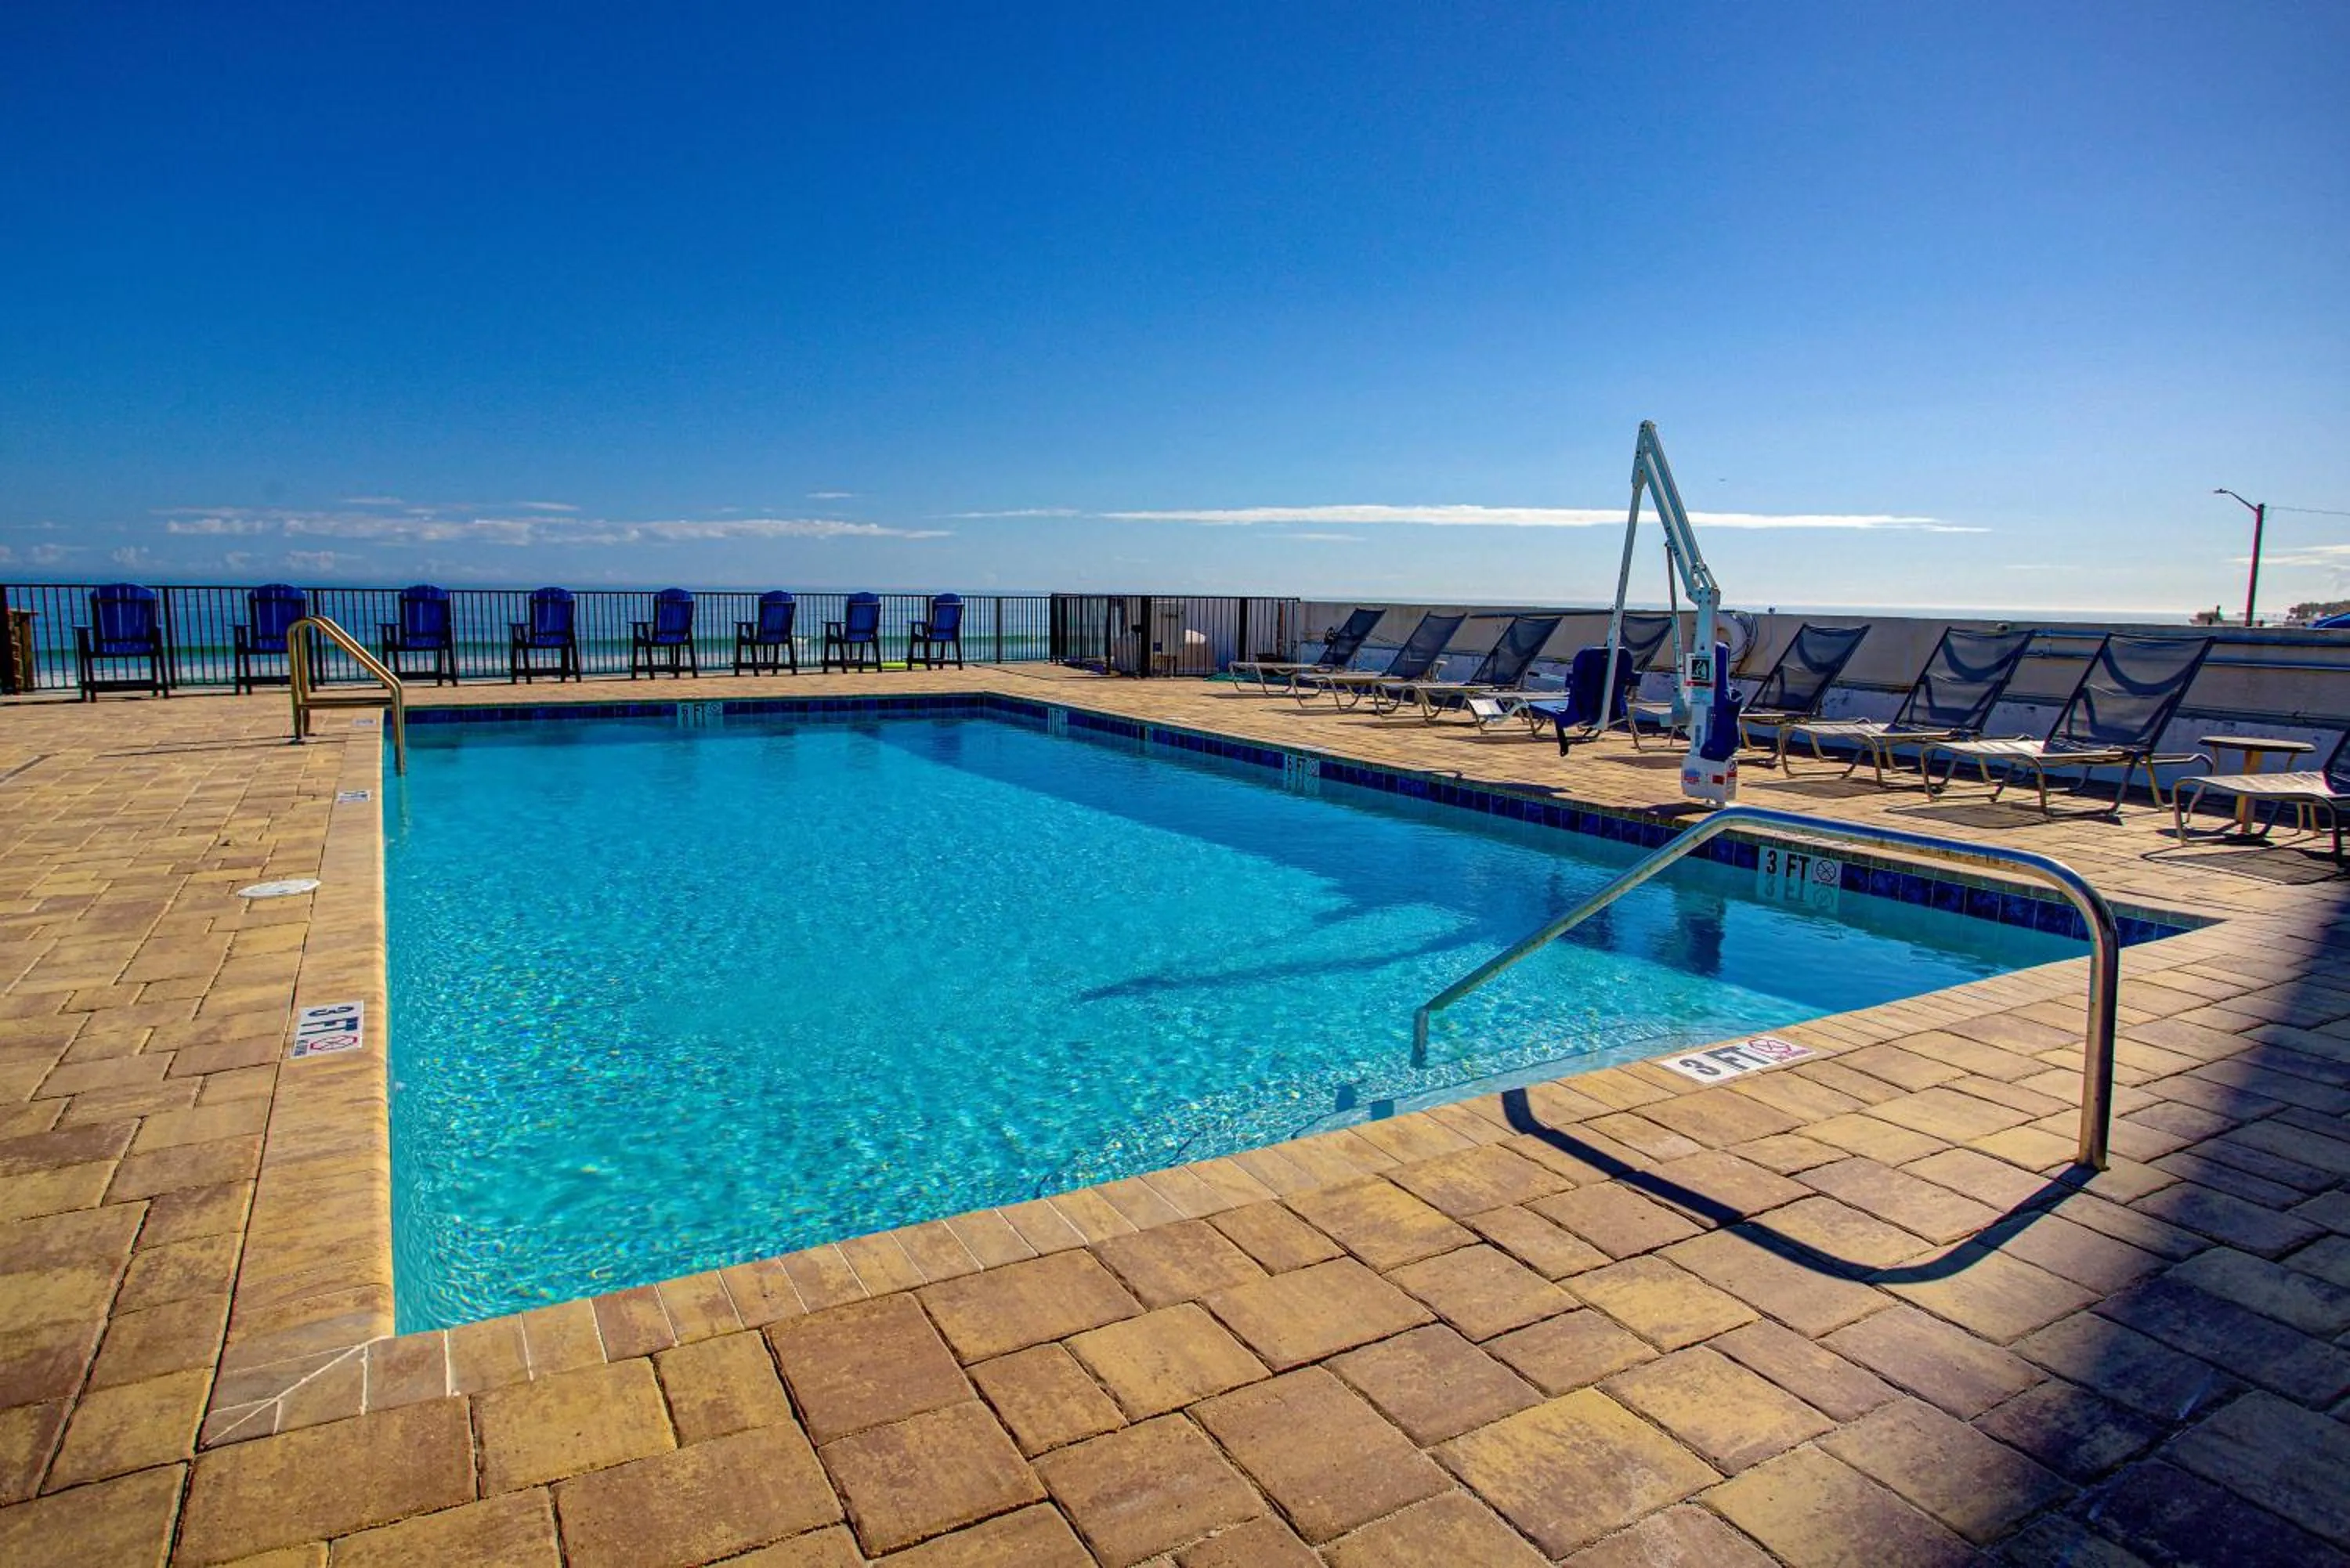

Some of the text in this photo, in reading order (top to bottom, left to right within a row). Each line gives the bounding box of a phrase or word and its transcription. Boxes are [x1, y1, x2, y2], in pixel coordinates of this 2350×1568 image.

[1766, 850, 1811, 880] 3 FT
[300, 1006, 359, 1036] 3 FT
[1679, 1058, 1721, 1076] 3
[1703, 1045, 1770, 1071] FT
